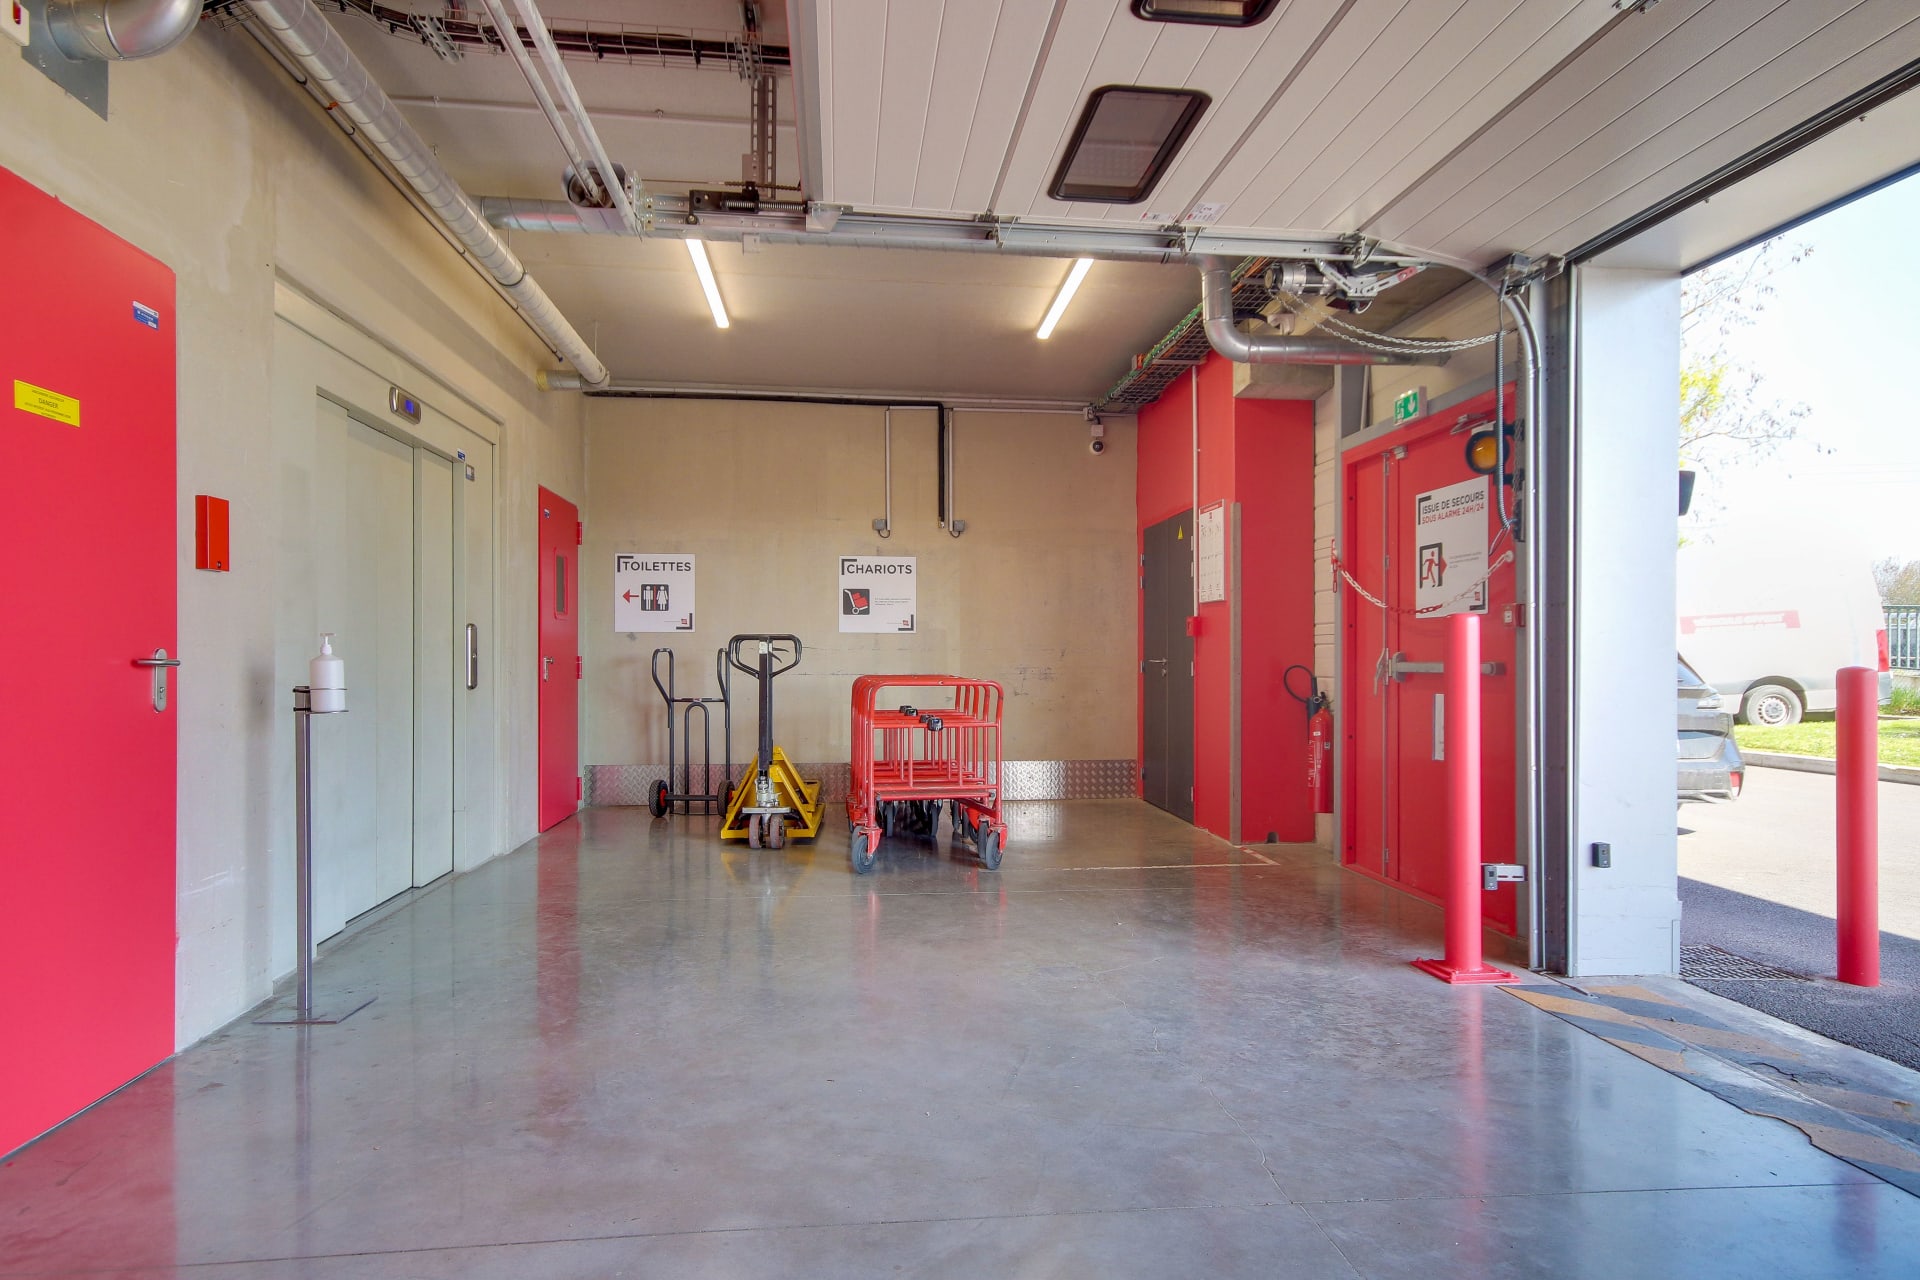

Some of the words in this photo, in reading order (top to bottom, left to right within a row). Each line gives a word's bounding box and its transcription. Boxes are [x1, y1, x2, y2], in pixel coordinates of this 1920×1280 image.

[38, 398, 58, 408] DANGER
[1422, 502, 1440, 514] ISSUE
[1441, 499, 1450, 510] DE
[1451, 490, 1485, 507] SECOURS
[1422, 514, 1436, 525] SOUS
[1437, 507, 1461, 520] ALARME
[1462, 502, 1485, 515] 24H/24
[622, 561, 692, 572] TOILETTES
[846, 564, 913, 575] CHARIOTS
